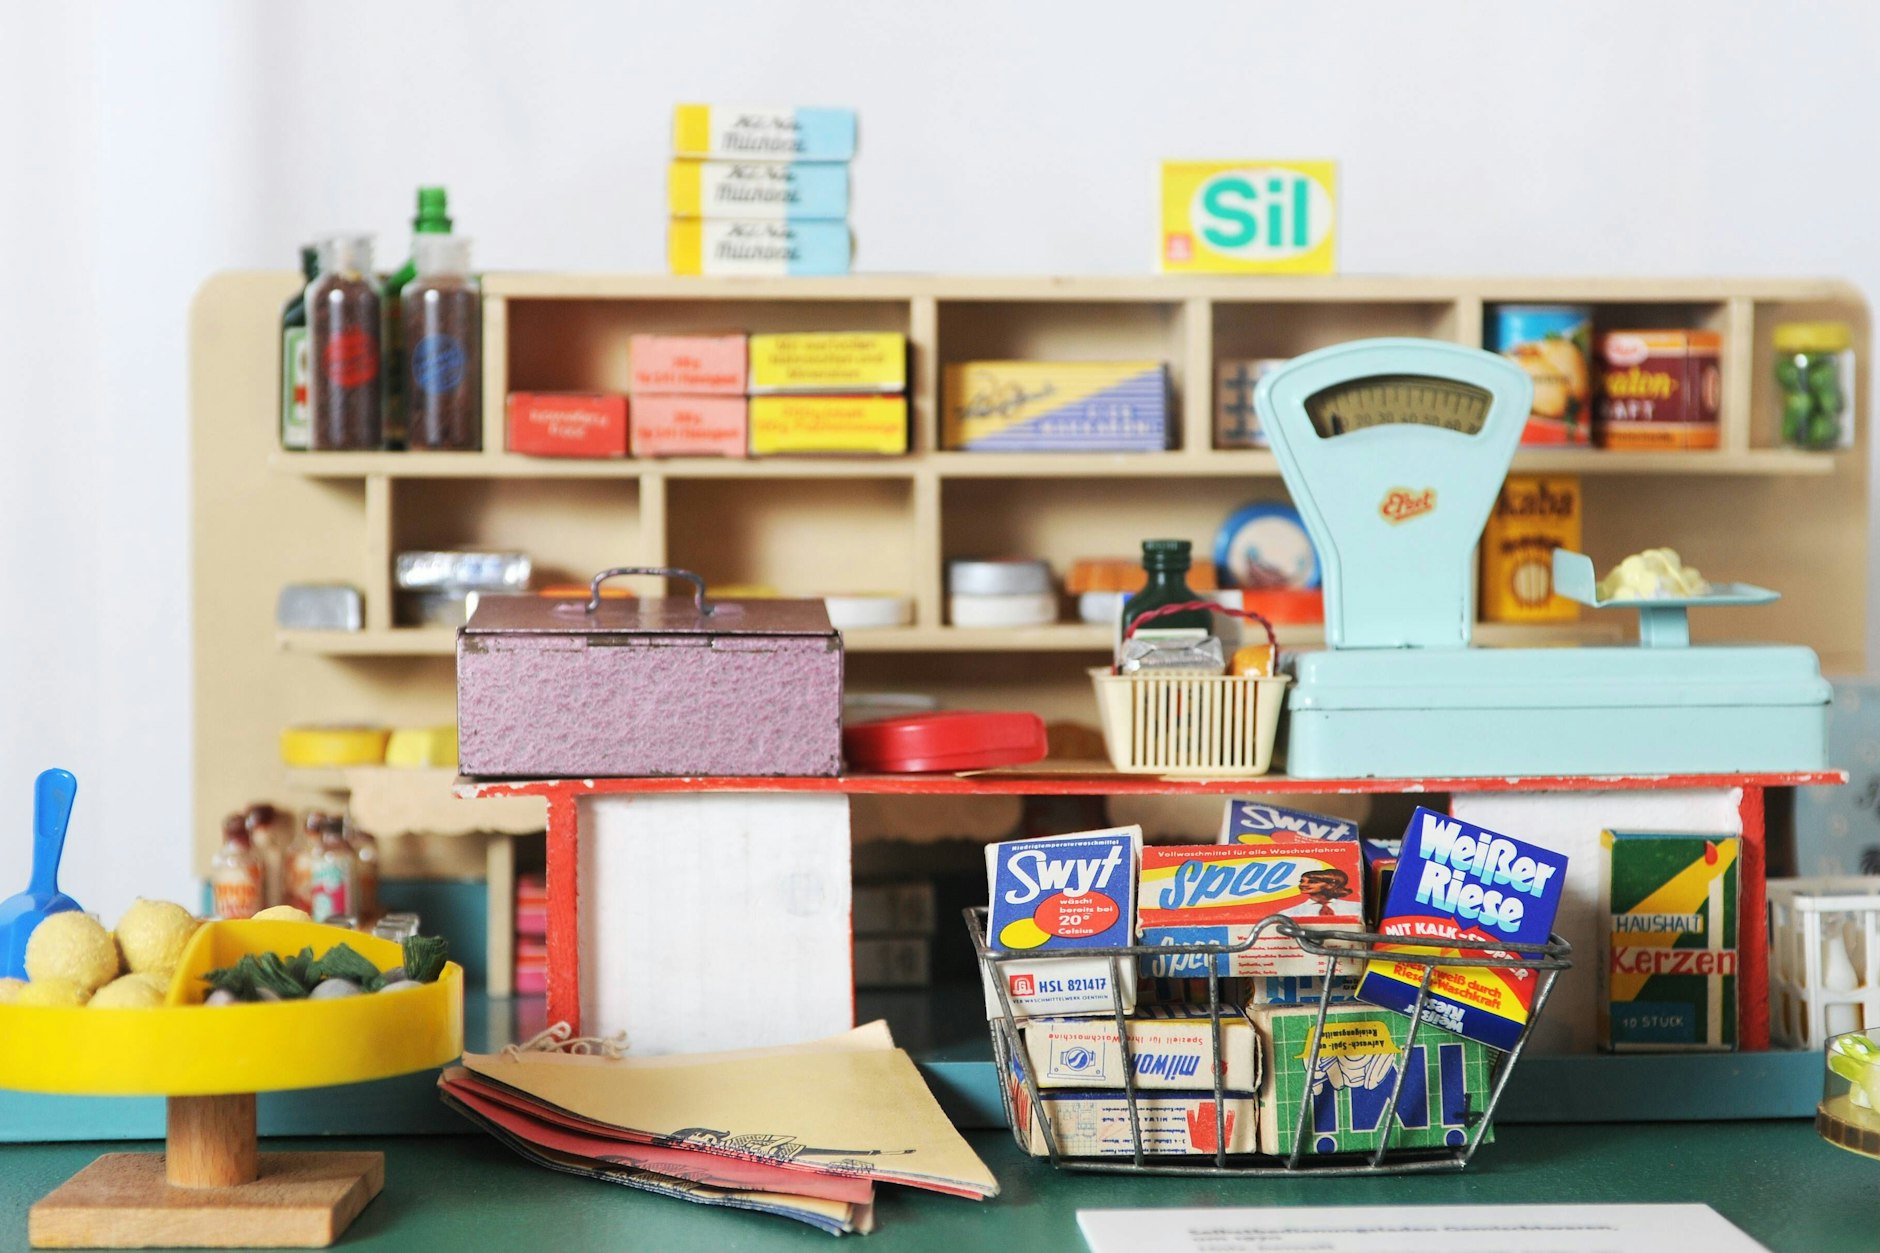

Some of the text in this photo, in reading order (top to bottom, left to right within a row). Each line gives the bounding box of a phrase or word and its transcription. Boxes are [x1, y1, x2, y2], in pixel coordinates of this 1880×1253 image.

[1203, 177, 1308, 248] Sil
[1240, 805, 1351, 842] Swyt
[1158, 847, 1346, 858] Vollwaschmittel für alle Waschverfahren
[1419, 813, 1556, 898] Weißer
[1005, 845, 1123, 904] Swyt
[1159, 859, 1297, 911] Spee
[1415, 860, 1525, 933] Riese
[1058, 913, 1091, 926] 20°
[1615, 914, 1701, 933] HAUSHALT
[1058, 927, 1094, 935] Celsius
[1384, 922, 1412, 937] MIT
[1611, 945, 1737, 975] Kerzen
[1039, 980, 1063, 993] HSL
[1067, 978, 1107, 991] 821417
[1467, 979, 1502, 999] durch
[1403, 1004, 1465, 1034] Weißr
[1622, 1017, 1638, 1028] 10
[1048, 1033, 1122, 1043] Waschmaschine
[1149, 1035, 1161, 1044] für
[1166, 1035, 1203, 1045] Speziell
